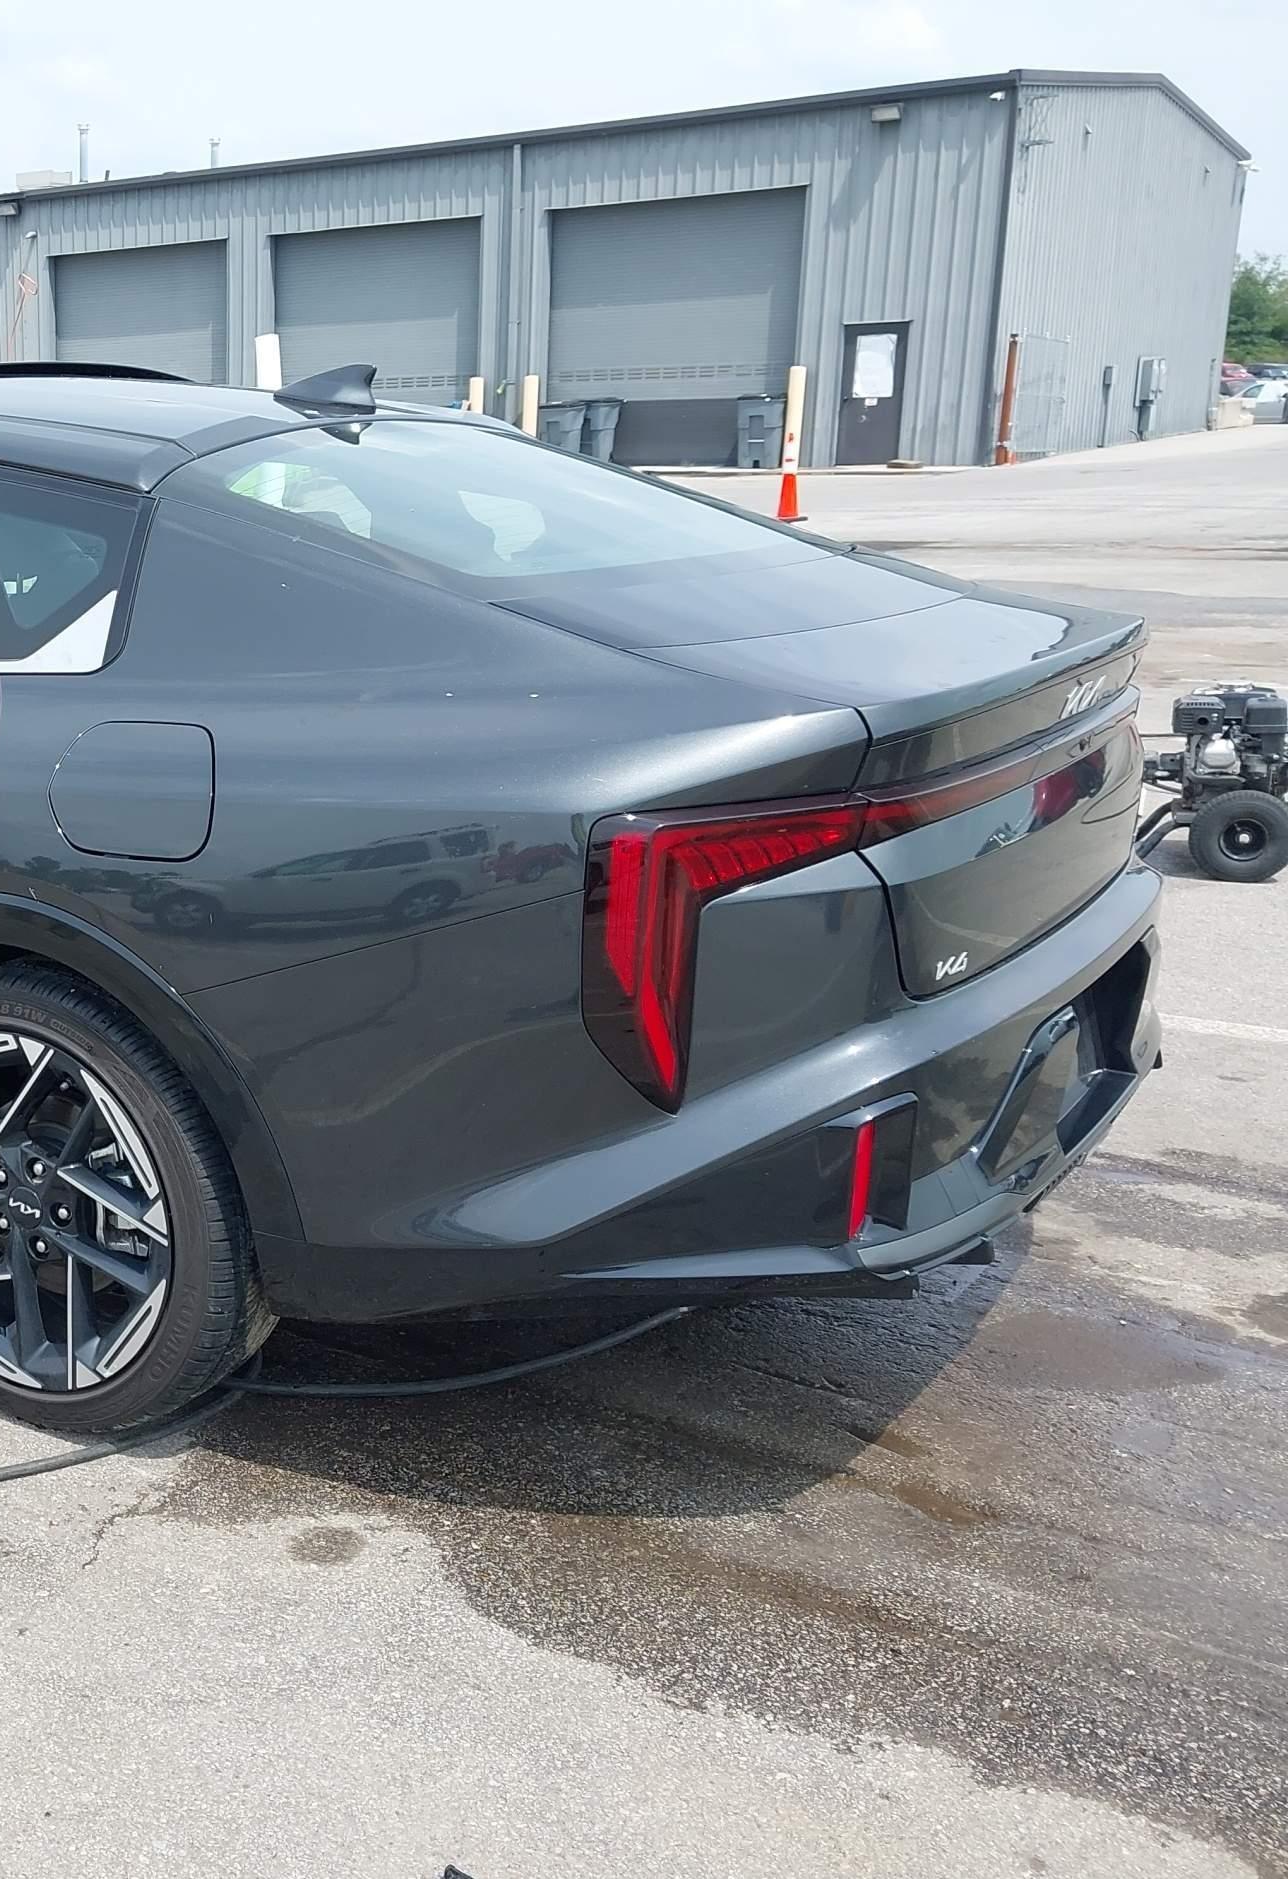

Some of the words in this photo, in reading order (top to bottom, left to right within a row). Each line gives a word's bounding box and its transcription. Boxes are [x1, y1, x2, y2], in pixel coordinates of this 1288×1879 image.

[935, 951, 968, 980] K4
[13, 1006, 48, 1024] 91W
[149, 1282, 201, 1383] KUMHO
